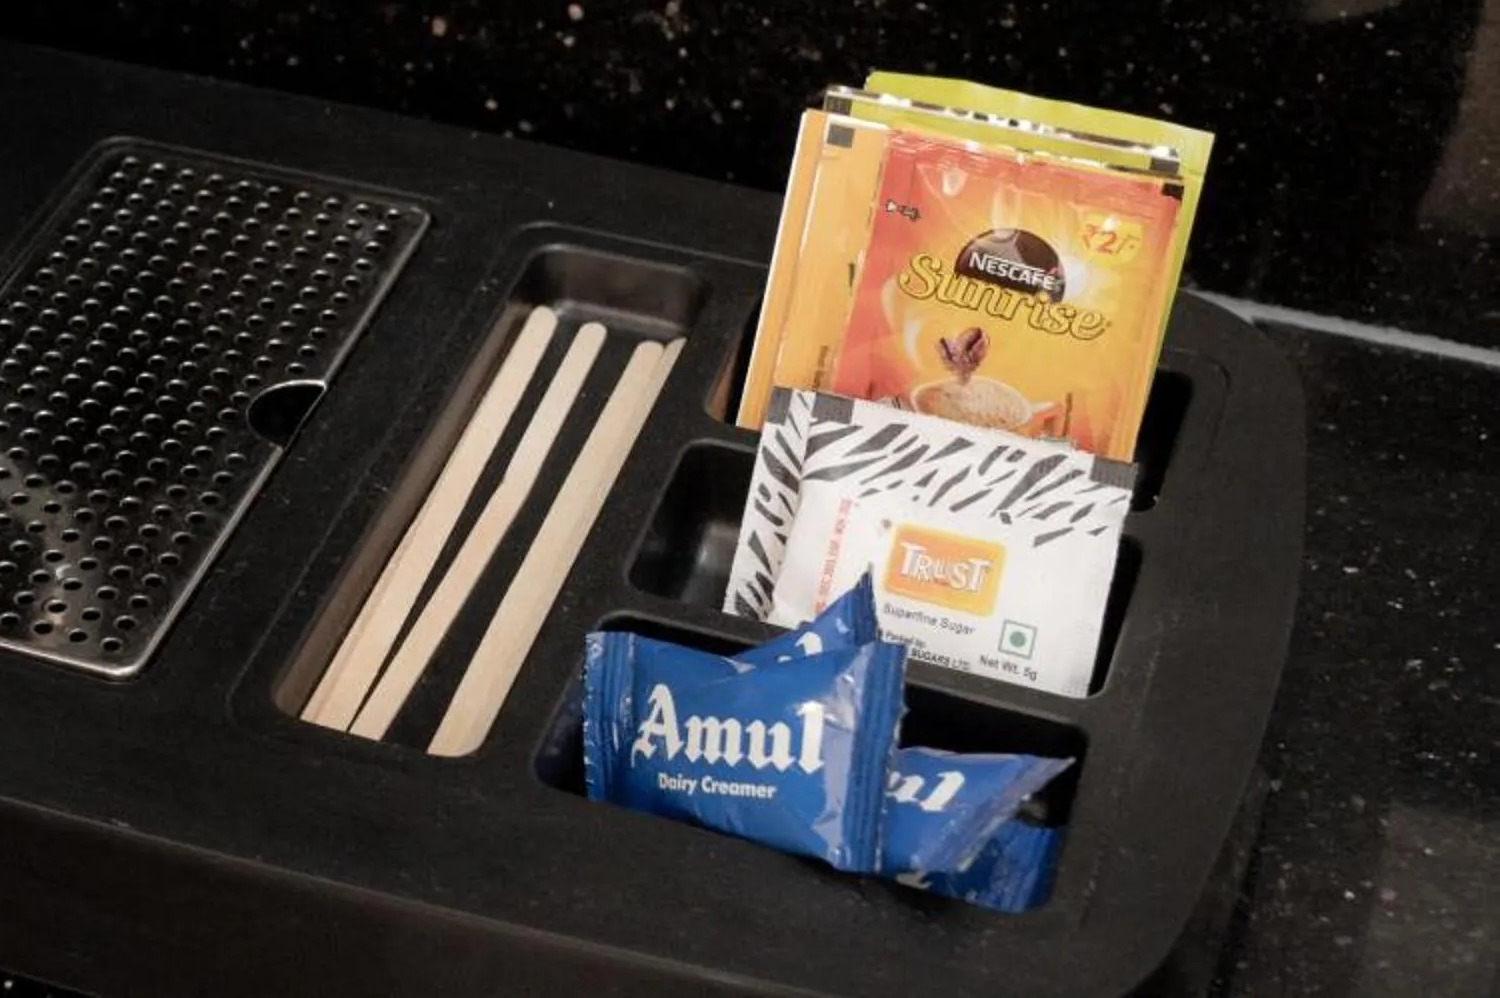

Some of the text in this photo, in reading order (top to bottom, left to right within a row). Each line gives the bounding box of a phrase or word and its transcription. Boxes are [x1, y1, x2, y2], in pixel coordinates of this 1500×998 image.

[899, 252, 1106, 341] Sunrise
[883, 601, 976, 636] Superfine Sugar
[980, 654, 998, 669] Net
[1024, 666, 1039, 683] 5g
[630, 683, 825, 775] Amul
[657, 772, 778, 799] Dairy Creamer
